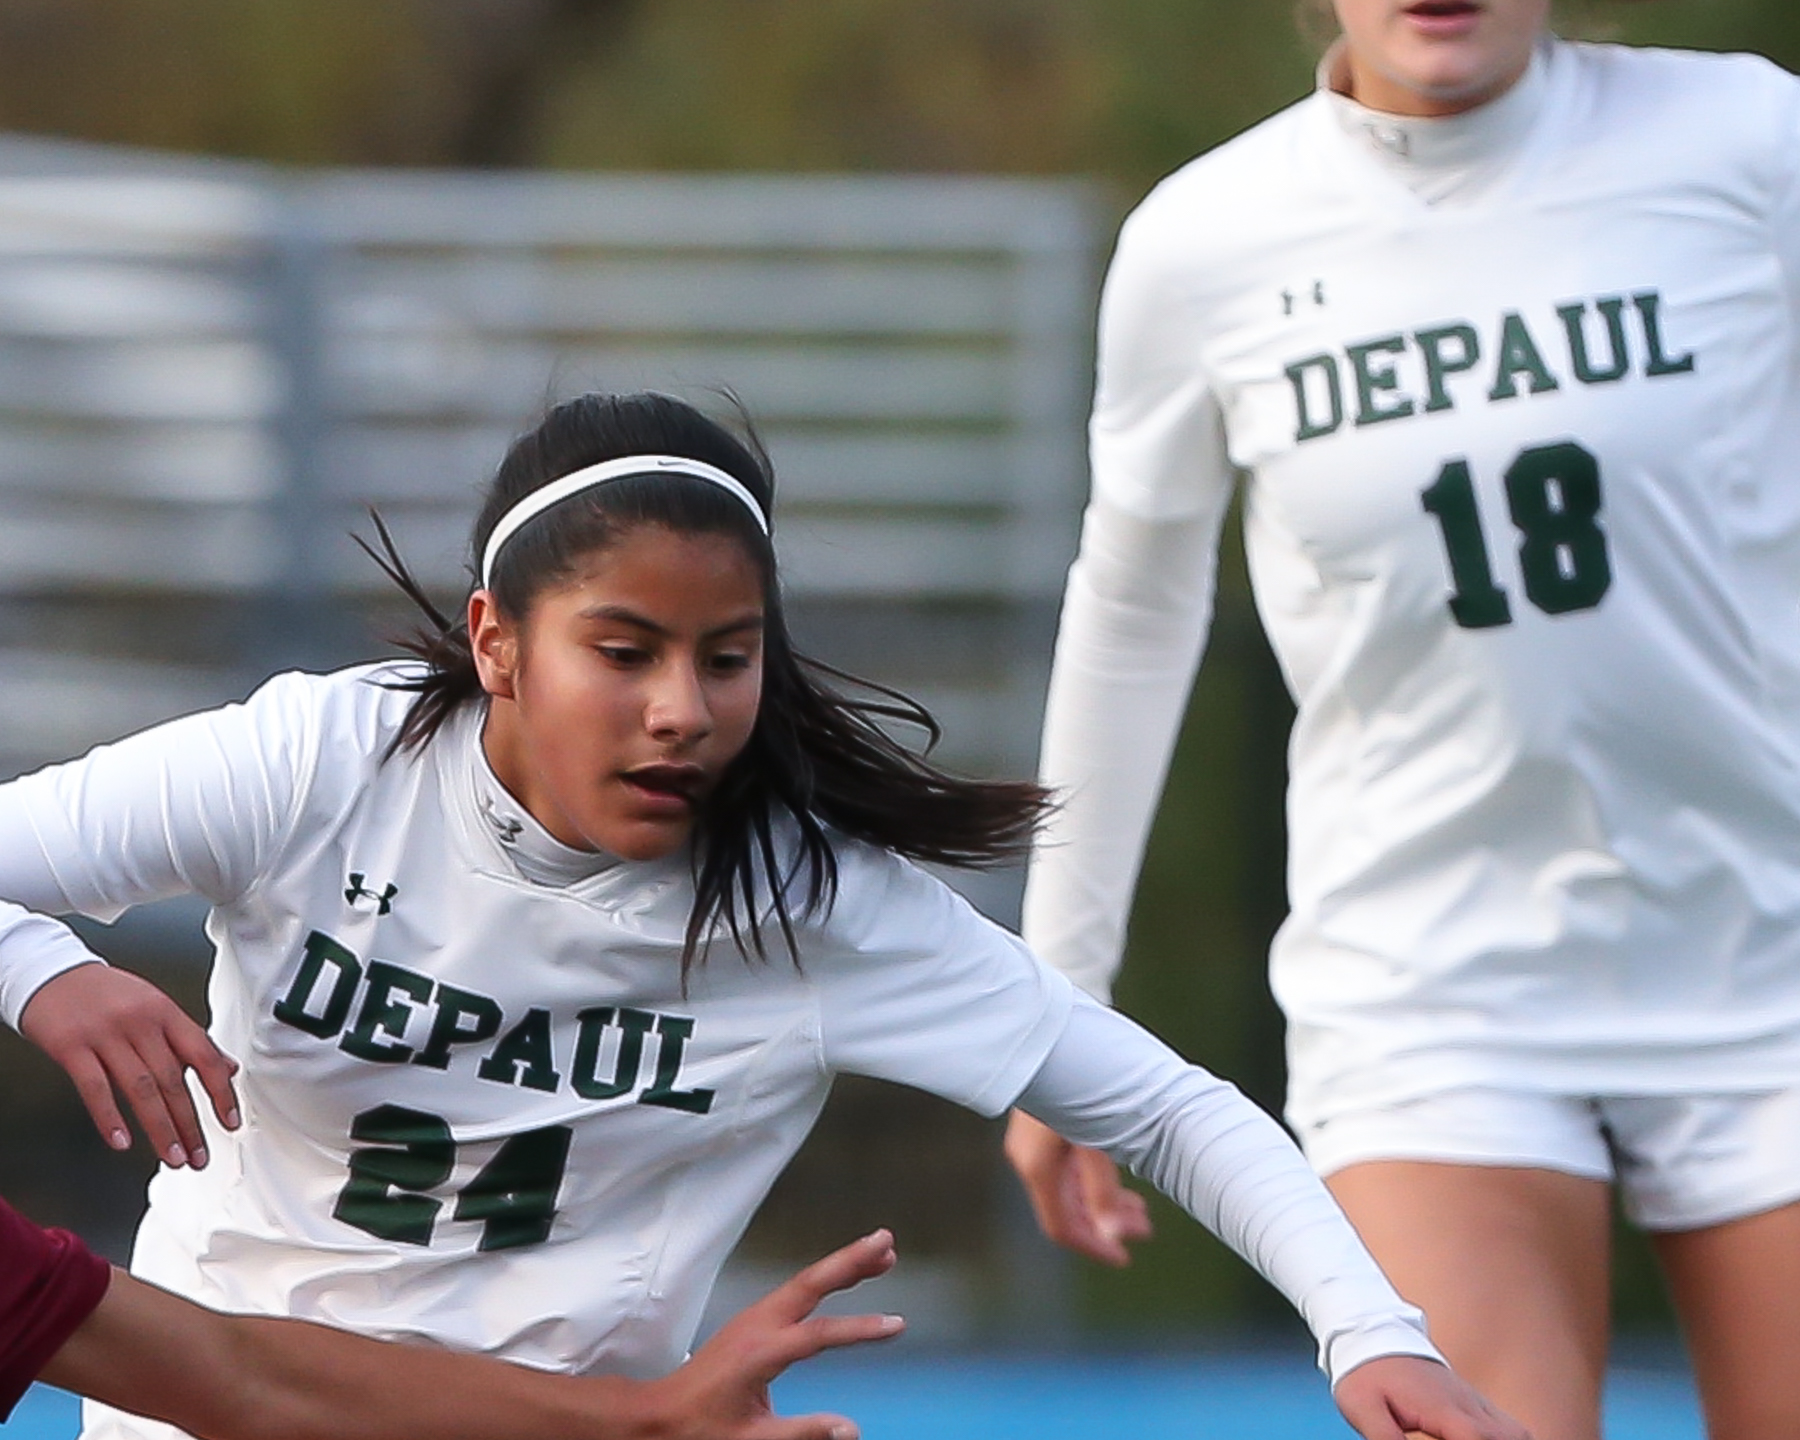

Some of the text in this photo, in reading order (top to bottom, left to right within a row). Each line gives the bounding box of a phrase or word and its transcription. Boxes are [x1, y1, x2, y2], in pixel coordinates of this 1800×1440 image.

[1284, 293, 1694, 442] DEPAUL
[1420, 442, 1612, 629] 18
[273, 929, 716, 1115] DEPAUL
[332, 1103, 573, 1253] 24
